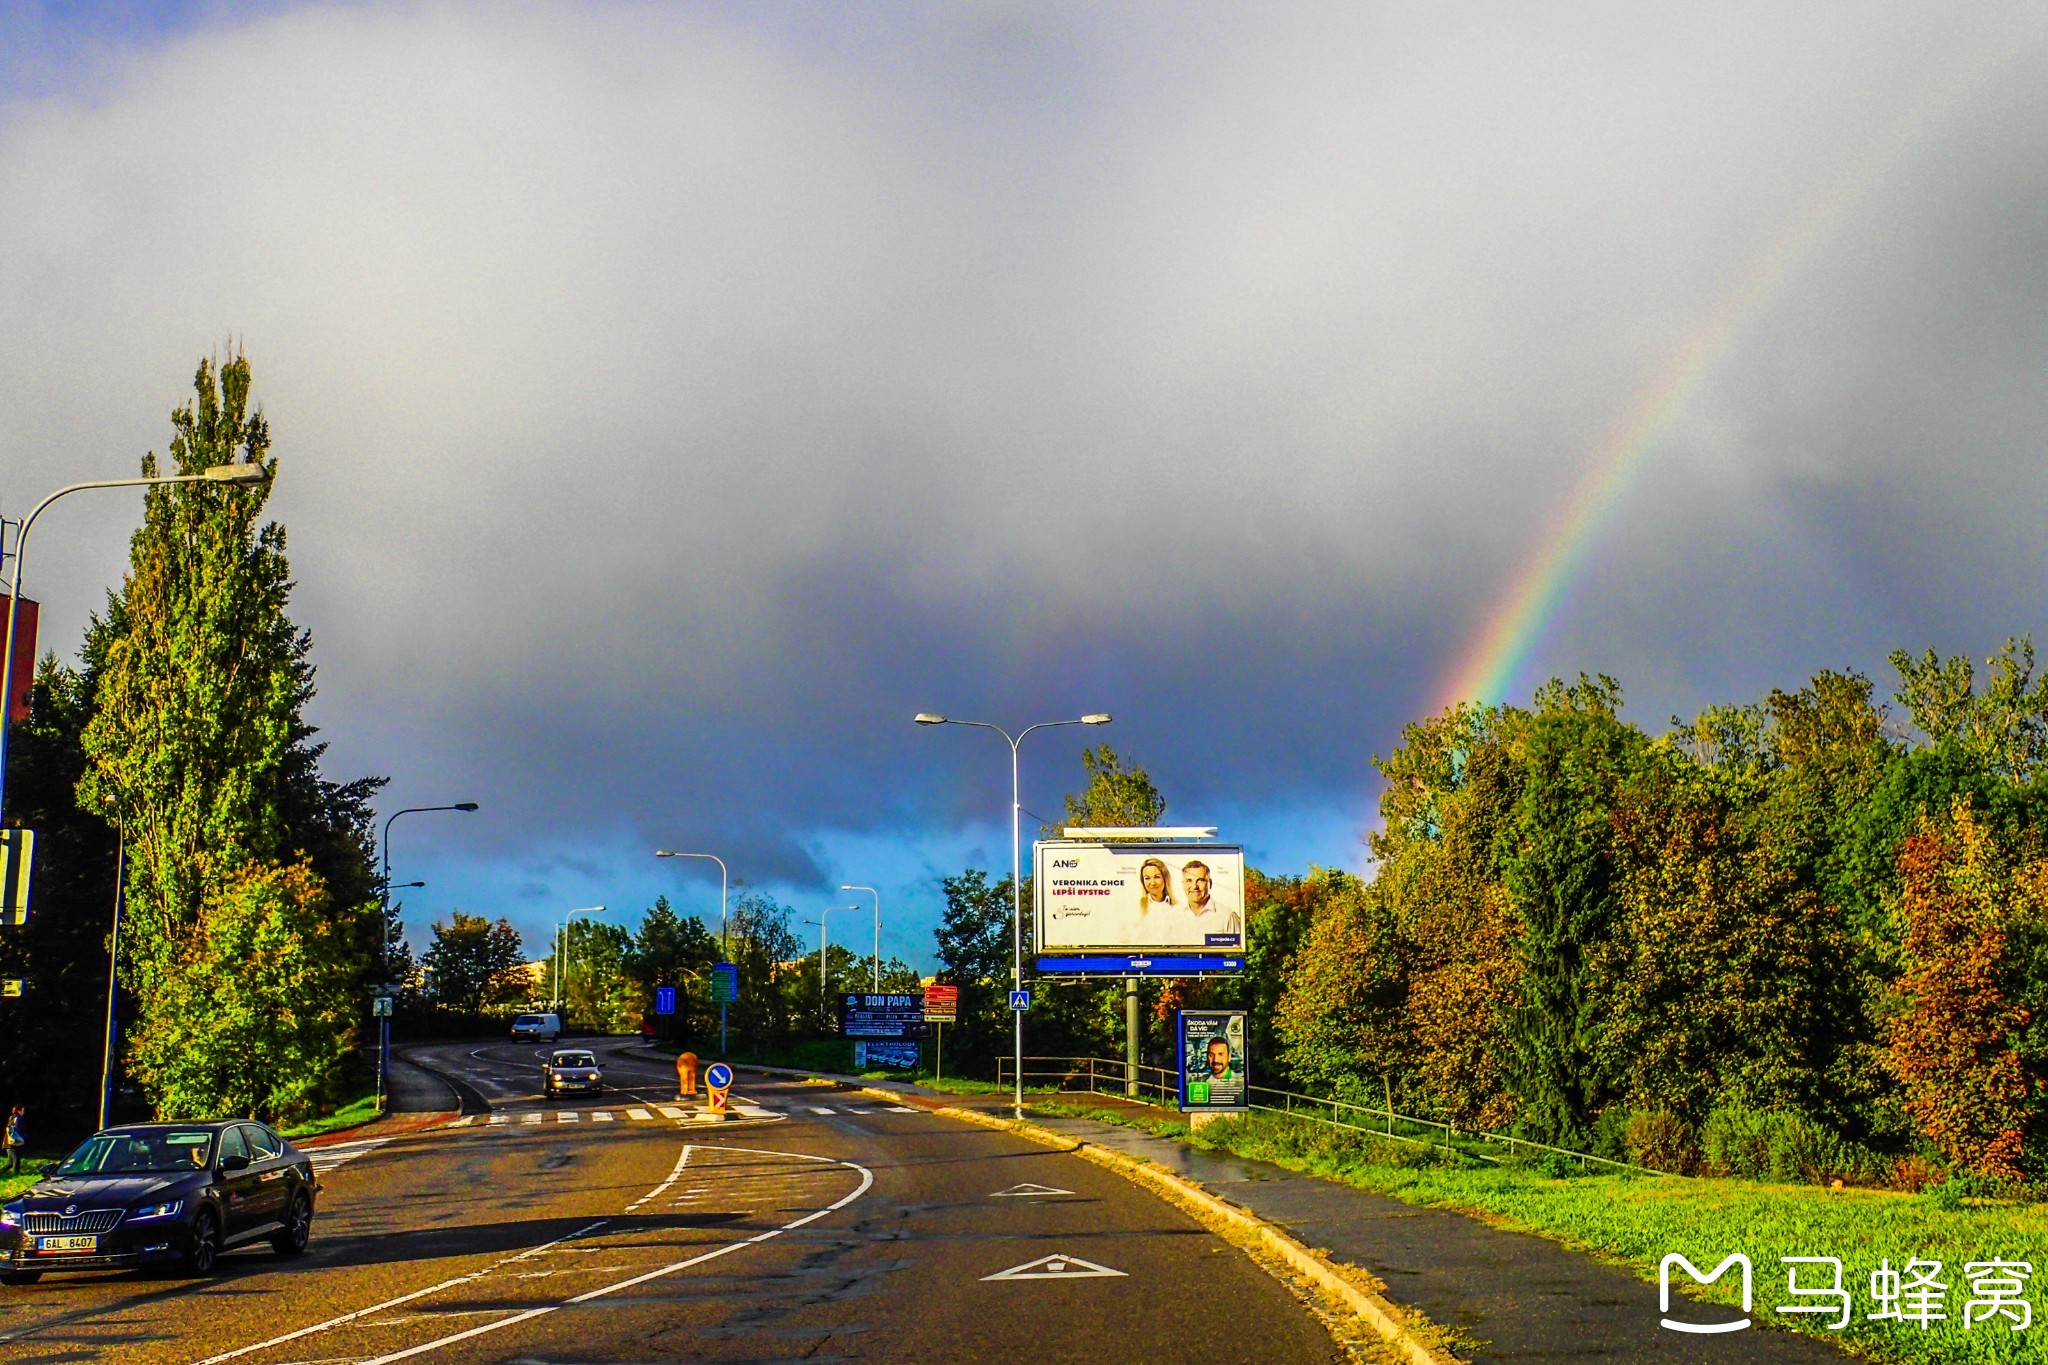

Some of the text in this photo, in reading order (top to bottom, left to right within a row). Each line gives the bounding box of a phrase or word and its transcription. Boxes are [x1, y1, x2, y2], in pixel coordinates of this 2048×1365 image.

[1053, 860, 1078, 868] ANO
[1052, 887, 1075, 895] LEPŠÍ
[865, 995, 911, 1006] DON PAPA
[46, 1238, 92, 1249] 6AL 8407
